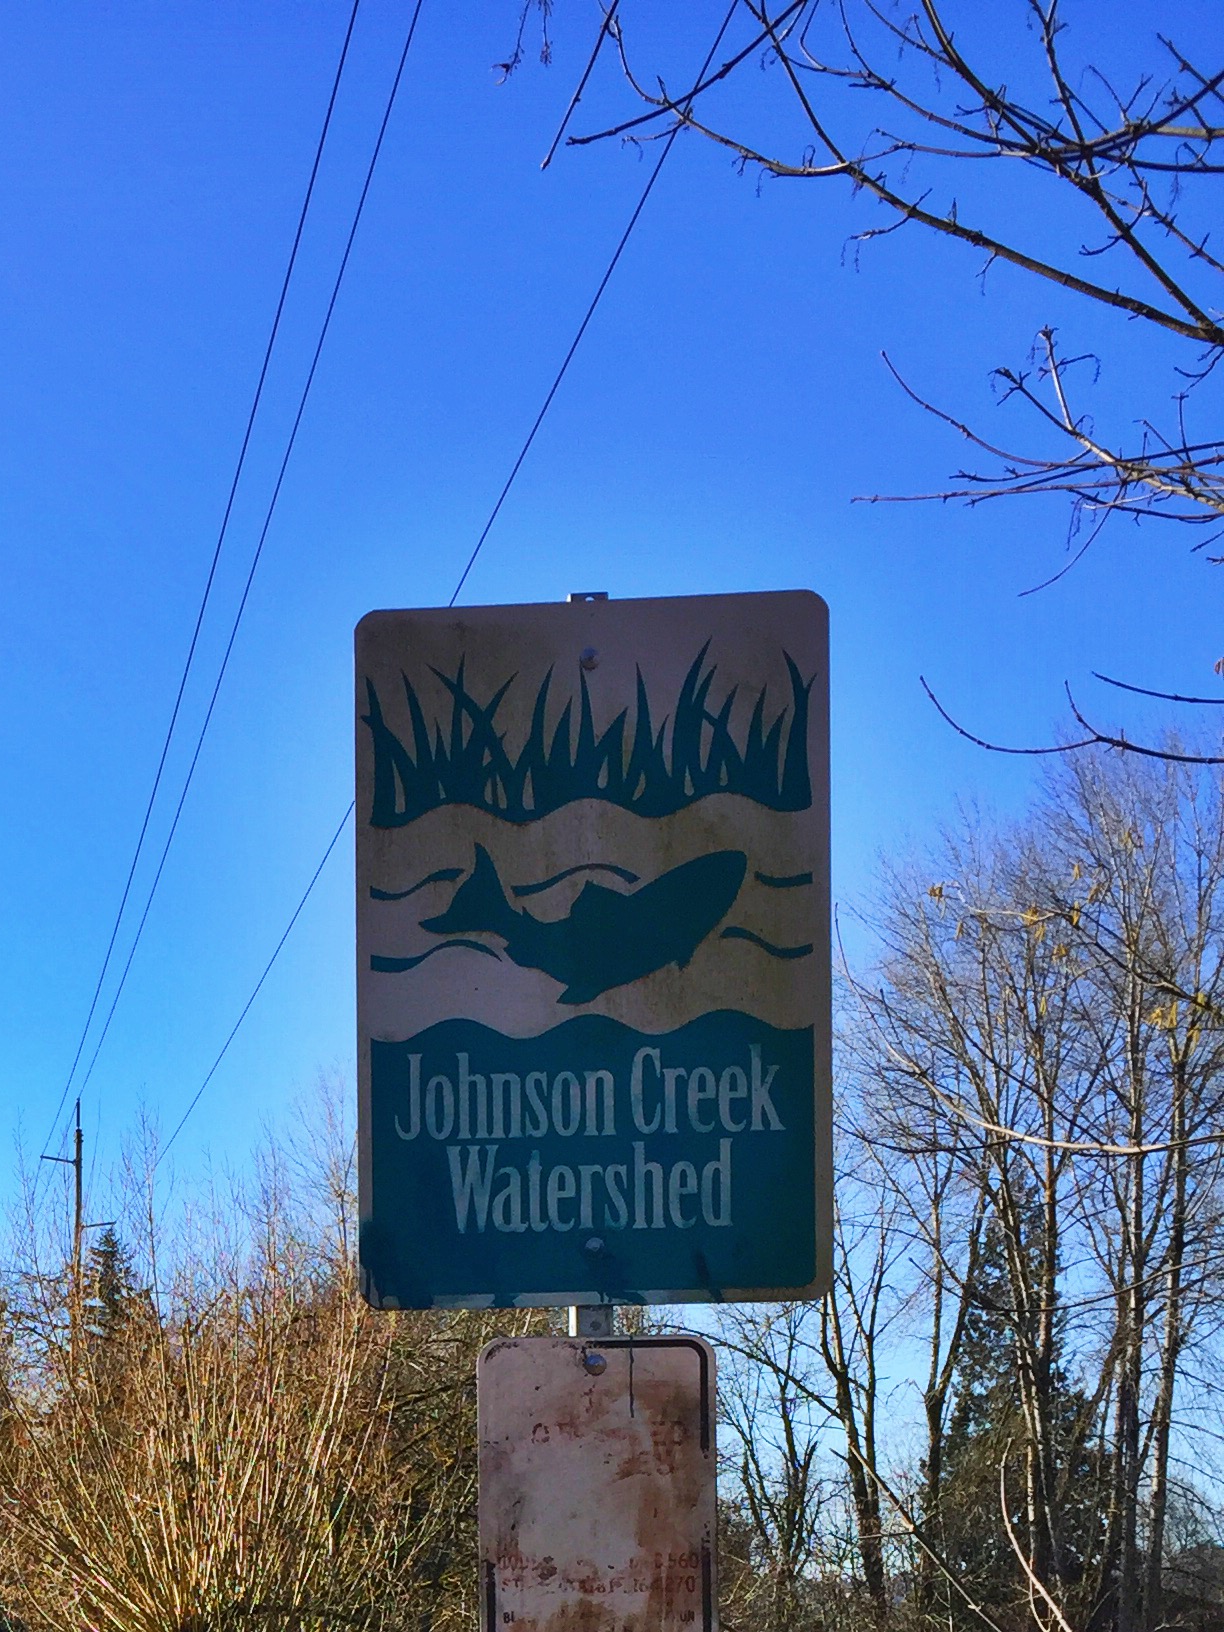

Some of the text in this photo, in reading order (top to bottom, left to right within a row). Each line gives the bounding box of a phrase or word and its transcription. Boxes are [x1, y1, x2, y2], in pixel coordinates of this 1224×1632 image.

[394, 1043, 786, 1141] Johnson Creek
[446, 1137, 734, 1235] Watershed
